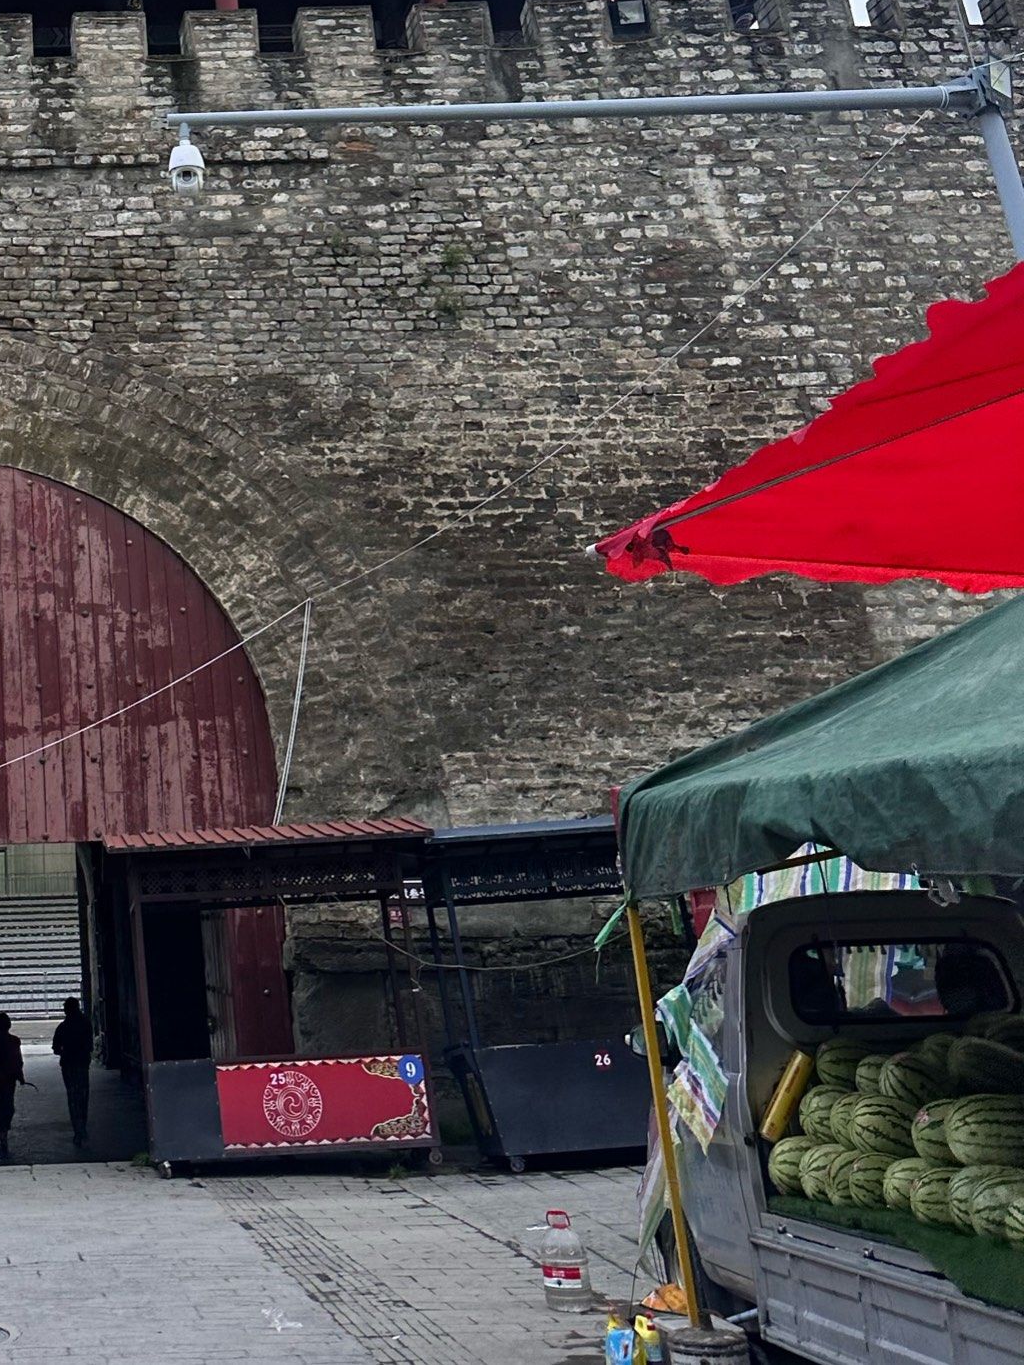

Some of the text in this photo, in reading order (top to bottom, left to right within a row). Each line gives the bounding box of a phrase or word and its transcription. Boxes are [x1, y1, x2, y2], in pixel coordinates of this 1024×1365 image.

[594, 1053, 612, 1066] 26
[405, 1061, 417, 1078] 9
[269, 1072, 287, 1085] 25
